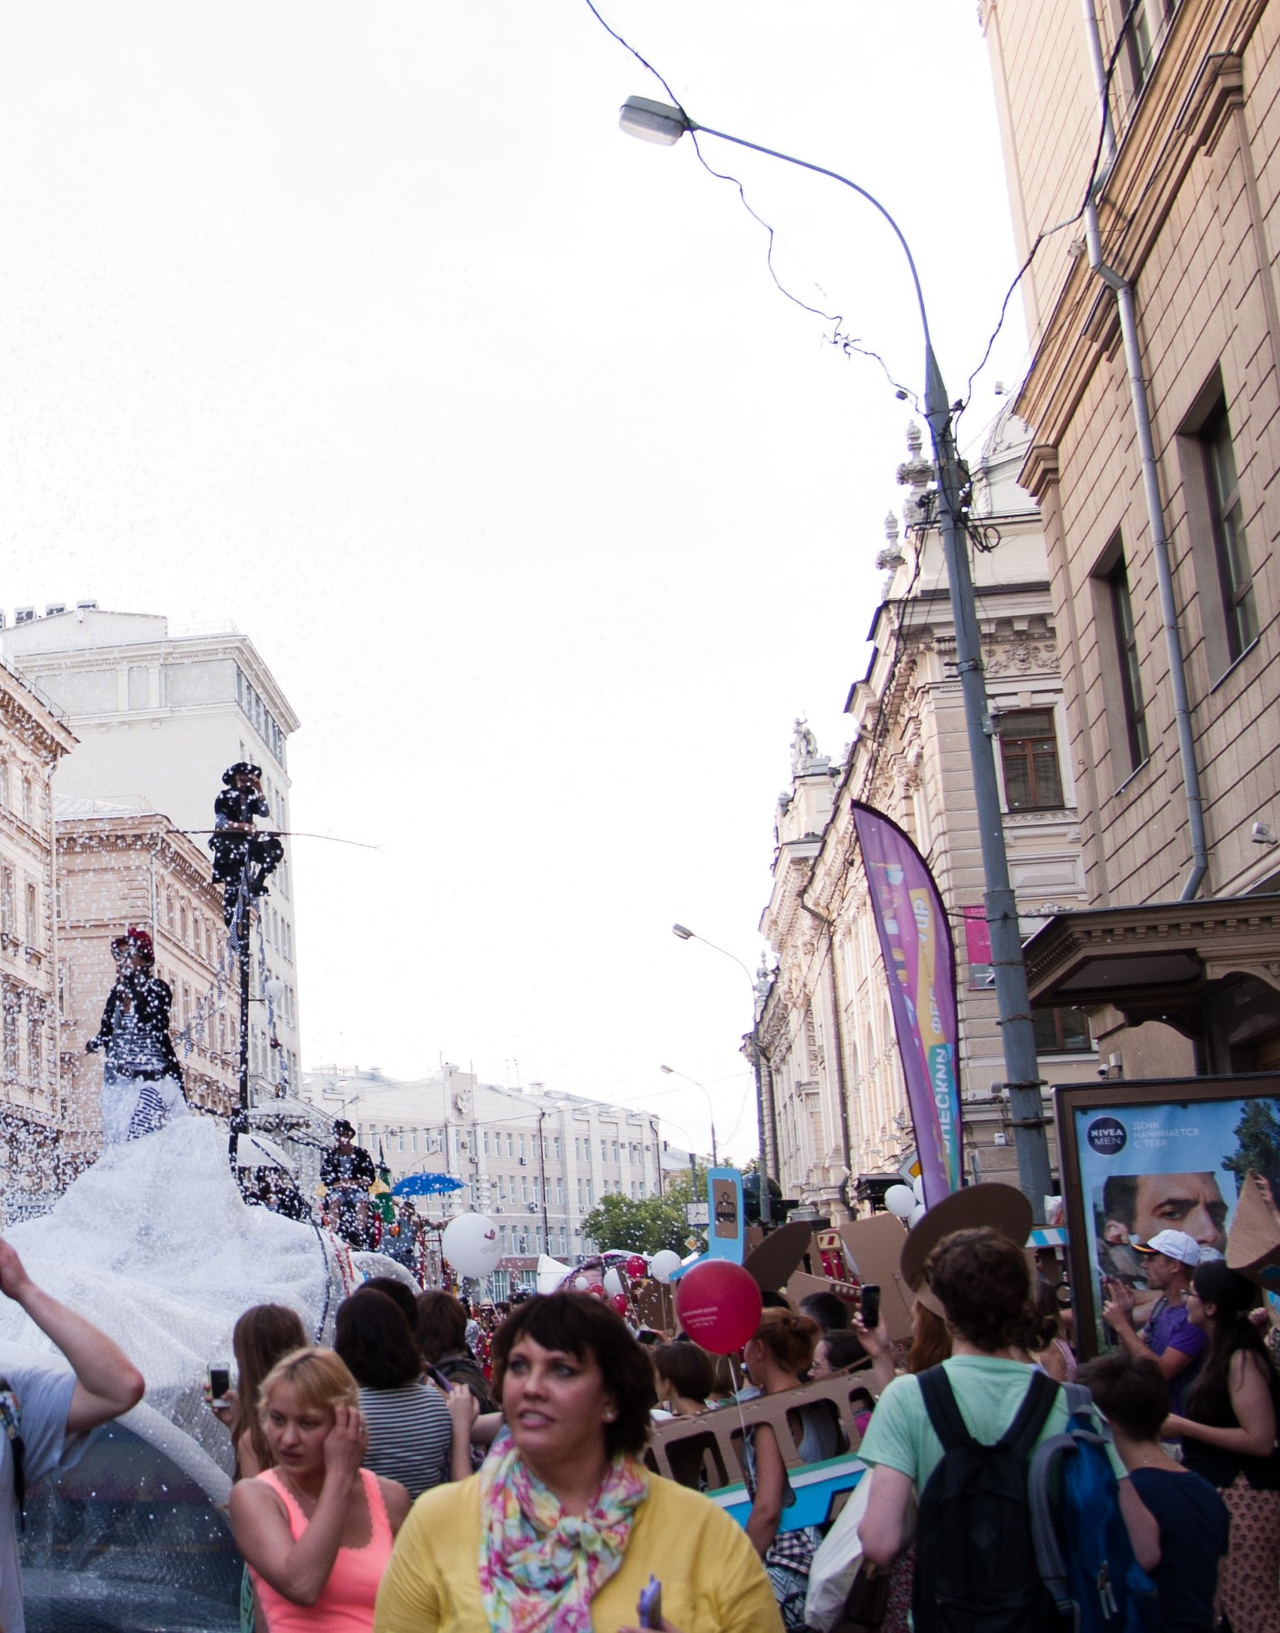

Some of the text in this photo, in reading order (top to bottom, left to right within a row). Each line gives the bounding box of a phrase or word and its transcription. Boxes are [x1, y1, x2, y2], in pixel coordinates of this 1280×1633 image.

[1133, 1121, 1159, 1129] ДЕНЬ
[1091, 1128, 1124, 1137] NIVEA
[1133, 1128, 1200, 1138] НАЧИНАЕТСЯ
[1094, 1137, 1121, 1146] MEN
[1143, 1139, 1168, 1148] ТЕБЯ
